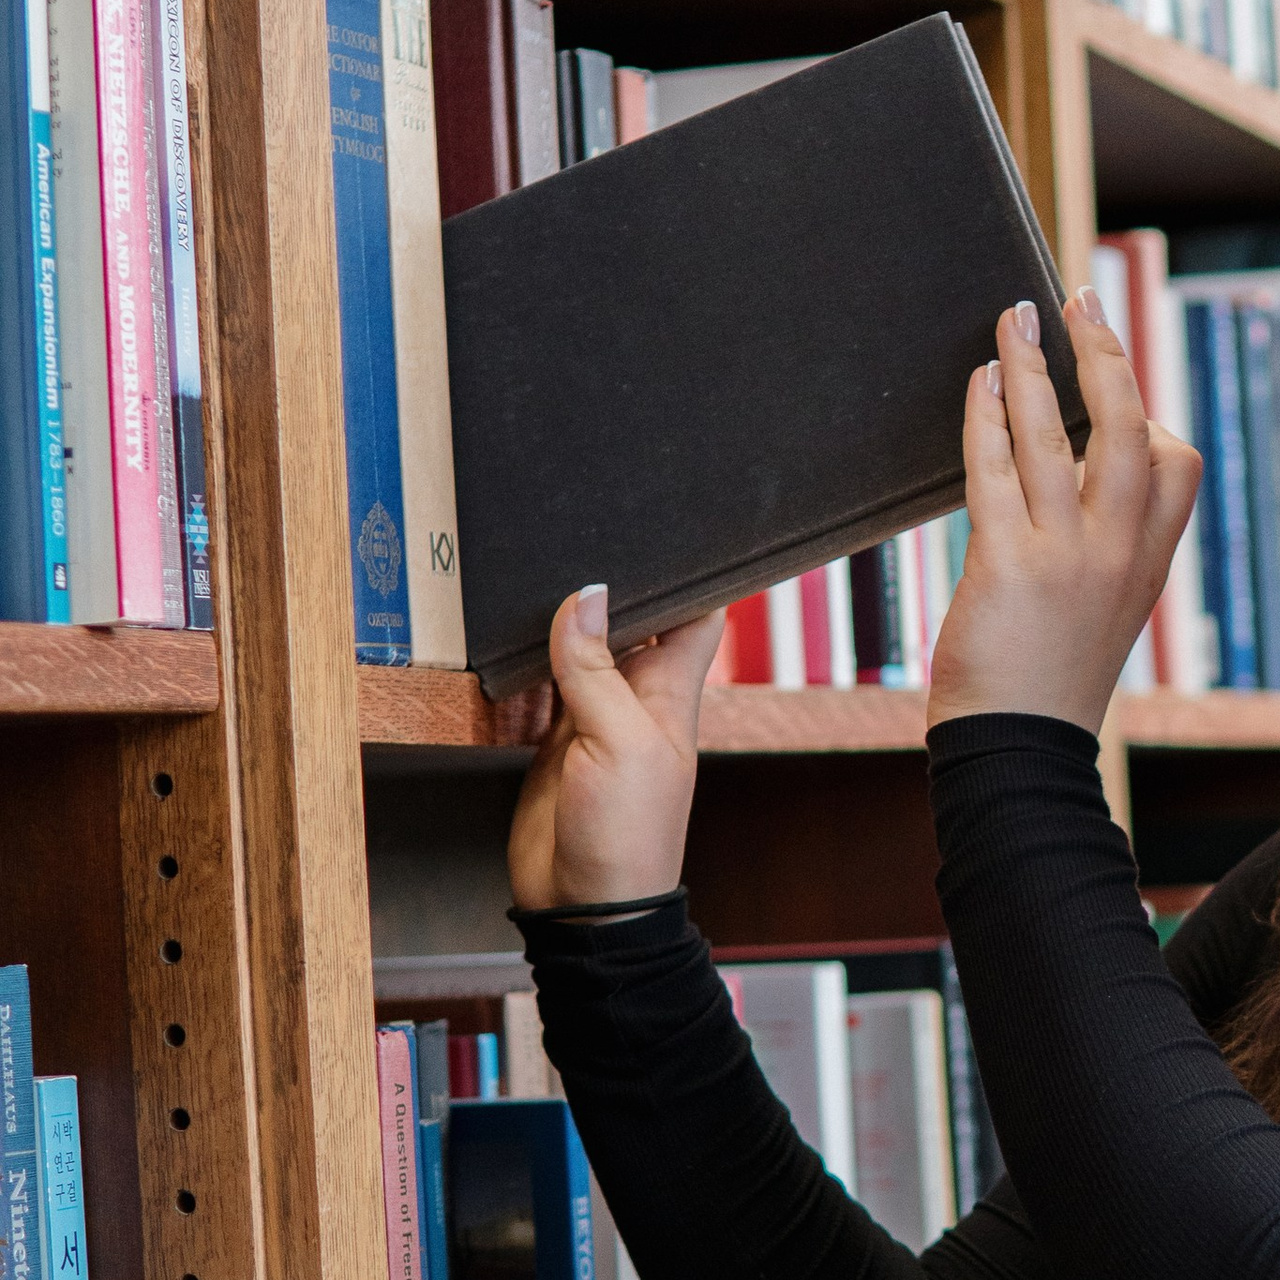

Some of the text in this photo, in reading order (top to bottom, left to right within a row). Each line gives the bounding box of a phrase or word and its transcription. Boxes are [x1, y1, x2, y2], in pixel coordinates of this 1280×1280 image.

[106, 32, 131, 219] NIETZSCHE,
[169, 79, 182, 114] OF
[331, 108, 379, 134] ENGLISH
[37, 143, 52, 248] American
[172, 118, 190, 251] DISCOVERY
[114, 228, 130, 278] AND
[40, 257, 59, 410] Expansionism
[181, 286, 190, 358] Hartley
[118, 284, 145, 472] MODERNITY
[193, 569, 210, 583] WSU
[367, 612, 404, 627] OXFORD
[0, 1004, 16, 1134] DAHLHAUS
[394, 1082, 405, 1096] A
[52, 1122, 65, 1205] 시연구
[63, 1120, 77, 1203] 박곤걸
[395, 1103, 408, 1197] Question
[401, 1203, 412, 1223] of
